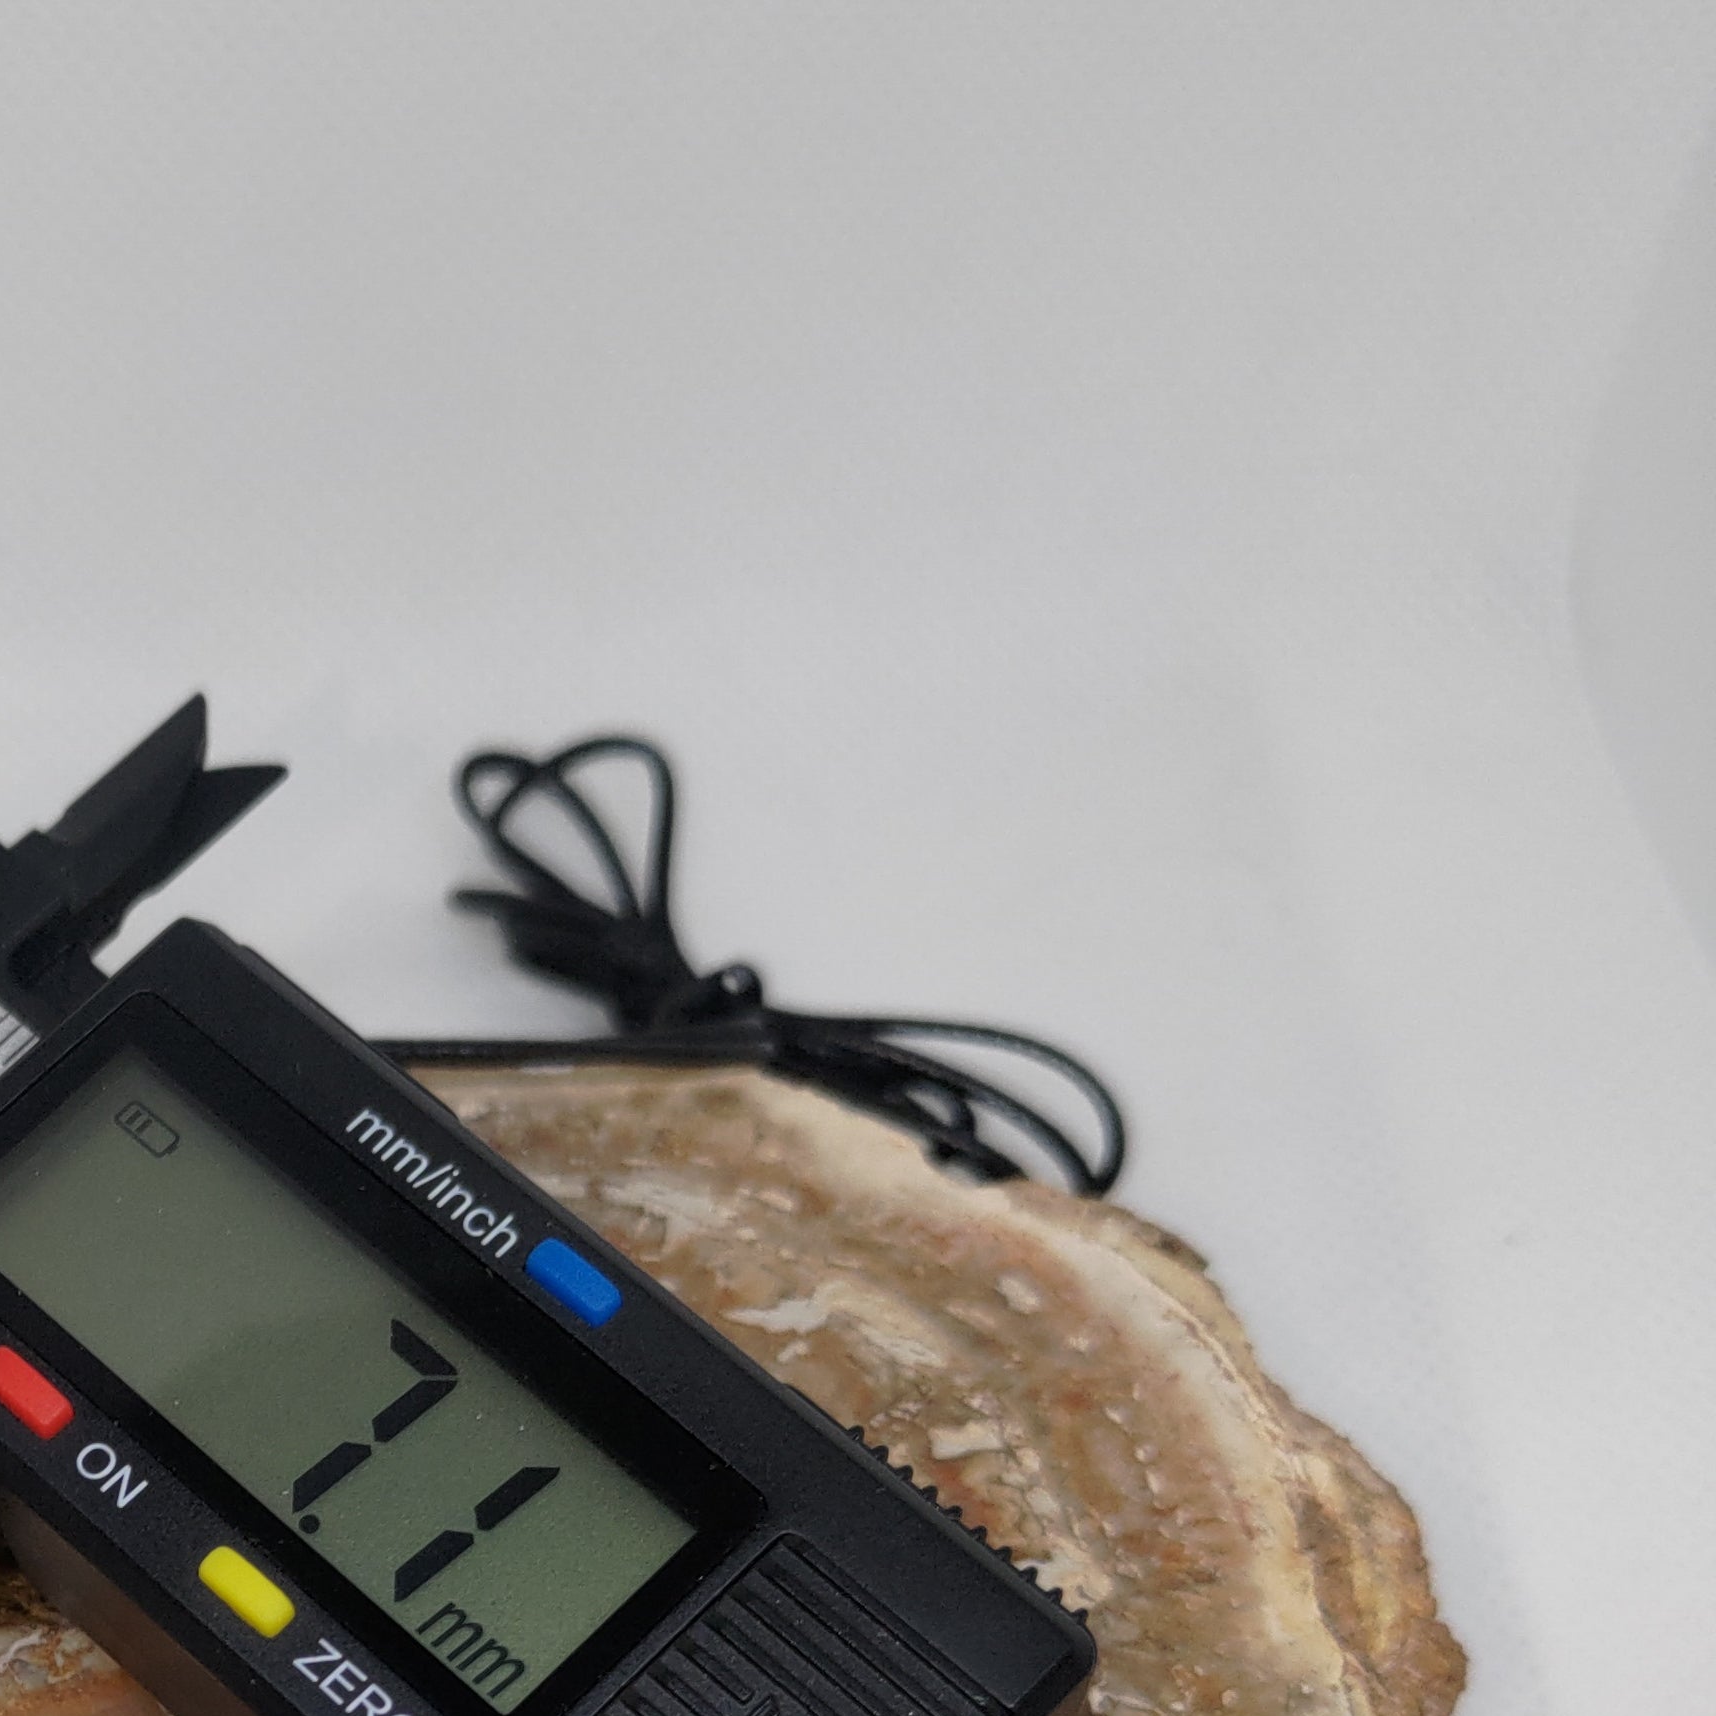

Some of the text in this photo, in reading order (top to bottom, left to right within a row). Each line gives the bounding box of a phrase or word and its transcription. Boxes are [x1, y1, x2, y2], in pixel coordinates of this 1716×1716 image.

[346, 1109, 519, 1258] mm/inch
[76, 1442, 149, 1509] ON
[292, 1318, 560, 1699] 7.1 mm
